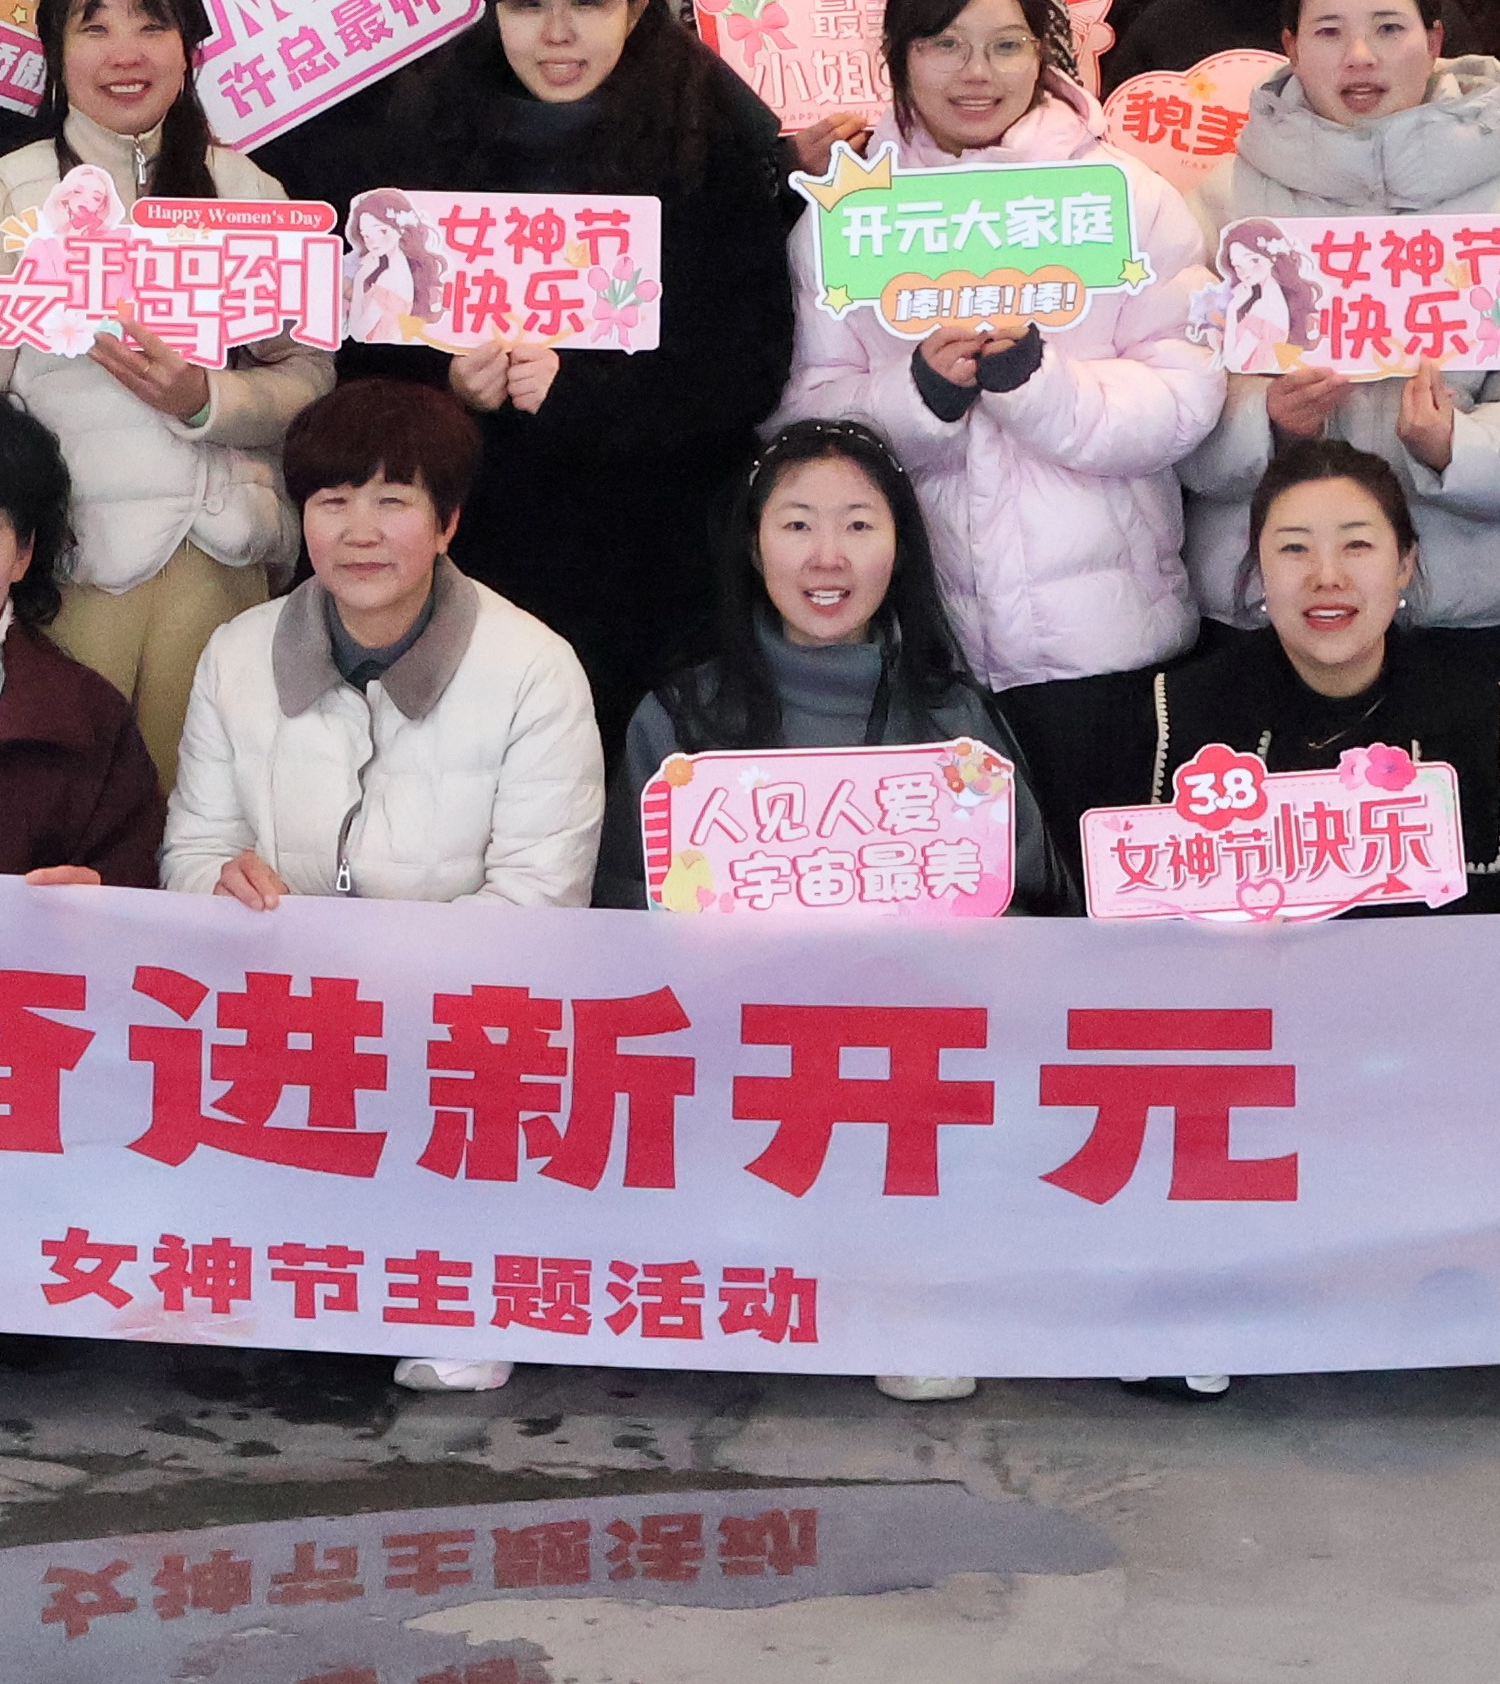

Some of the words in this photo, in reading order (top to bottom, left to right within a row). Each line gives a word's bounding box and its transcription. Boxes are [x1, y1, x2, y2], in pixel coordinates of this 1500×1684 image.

[147, 204, 204, 226] Happy
[208, 206, 285, 226] Women's
[290, 209, 324, 229] Day
[438, 204, 631, 266] 女神节
[841, 192, 1115, 257] 开元大家庭
[443, 268, 585, 336] 快乐
[1318, 290, 1470, 360] 快乐
[689, 772, 941, 847] 人见人爱
[1183, 767, 1259, 815] 3.8
[729, 837, 984, 911] 宇宙最美
[1110, 793, 1443, 895] 女神节快乐
